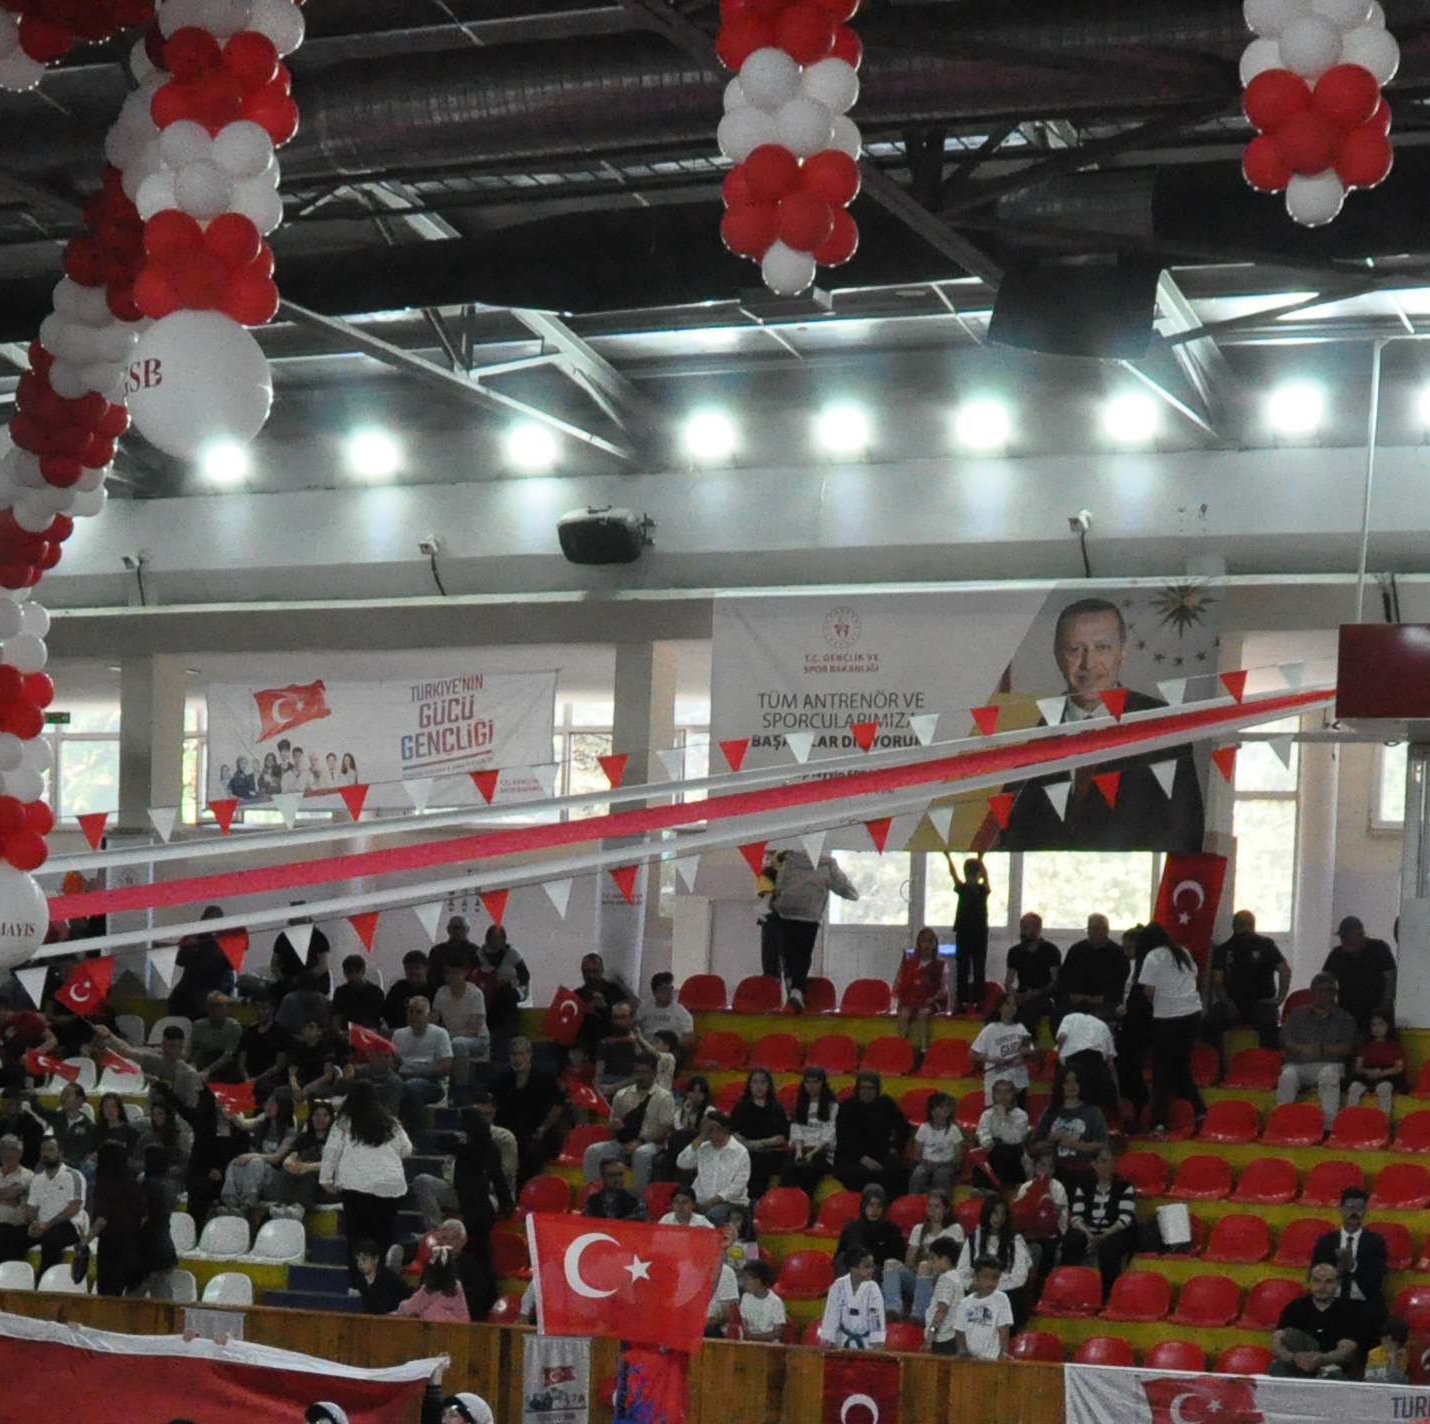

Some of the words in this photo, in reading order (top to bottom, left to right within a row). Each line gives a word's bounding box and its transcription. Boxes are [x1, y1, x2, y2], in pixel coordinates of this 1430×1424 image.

[804, 666, 828, 674] SPOR
[829, 663, 880, 674] BAKANLIĞI
[823, 652, 864, 664] GENÇLİK
[868, 653, 879, 662] VE
[758, 690, 798, 709] TÜM
[802, 689, 899, 710] ANTRENÖR
[902, 692, 926, 709] VE
[419, 694, 476, 729] GÜCÜ
[401, 718, 494, 761] GENÇLİĞİ
